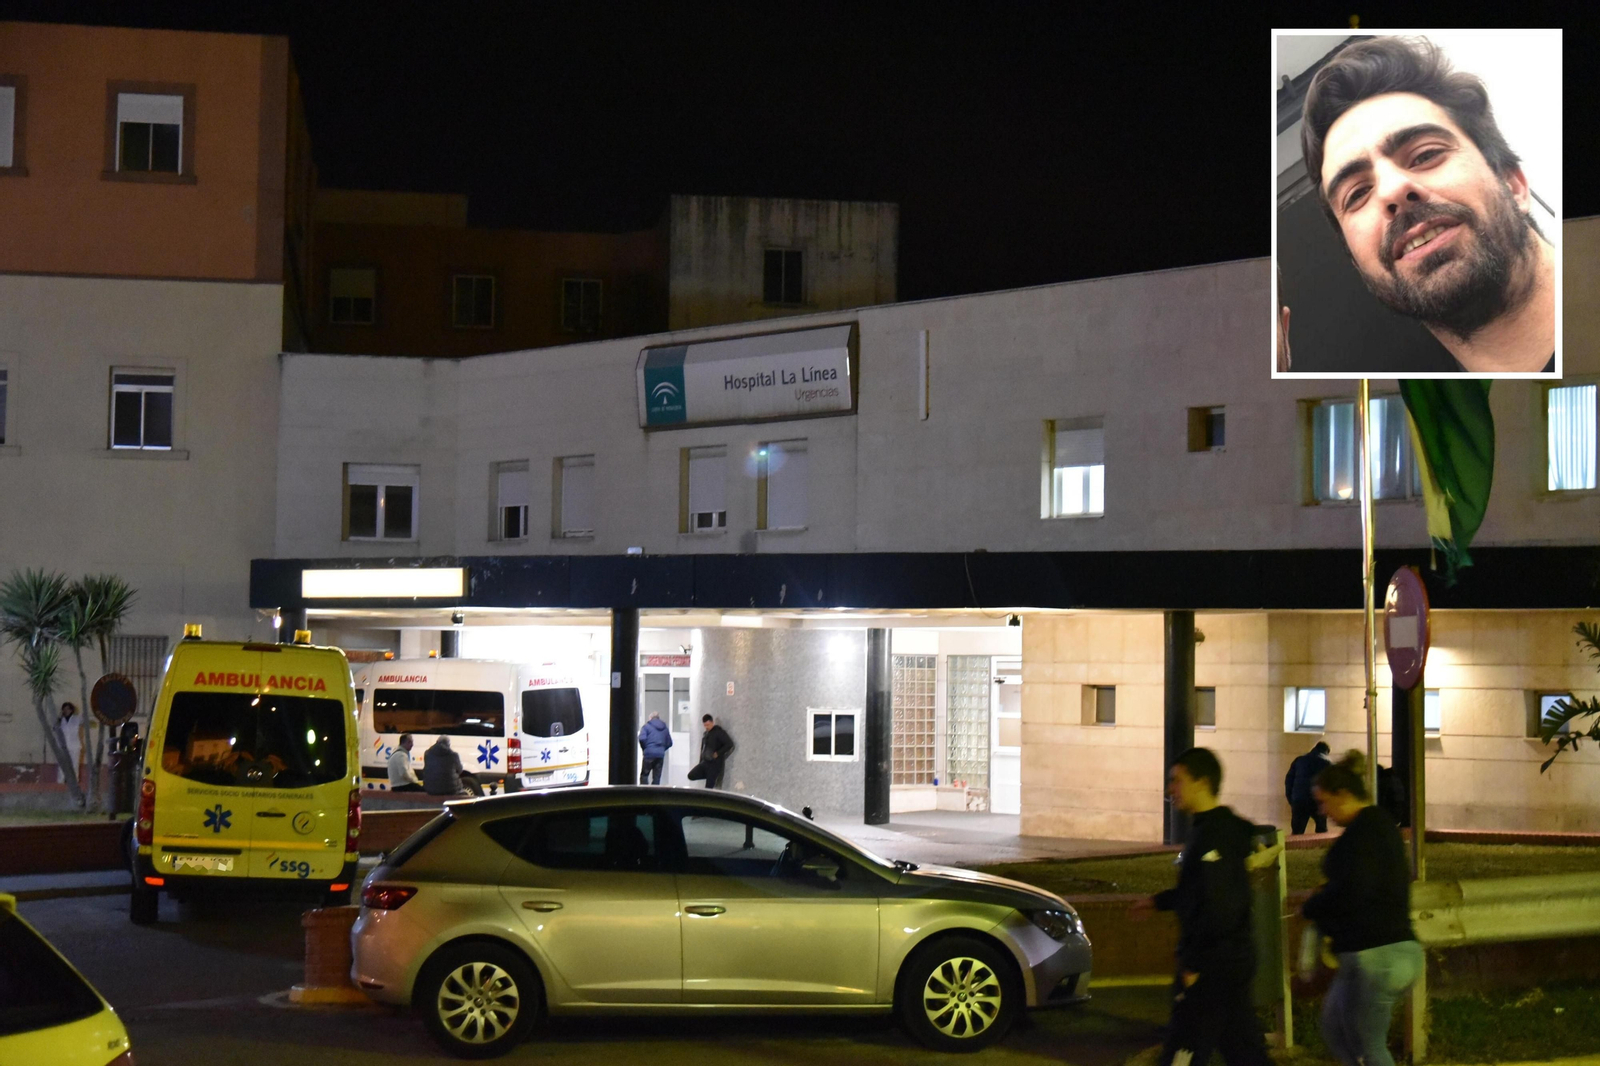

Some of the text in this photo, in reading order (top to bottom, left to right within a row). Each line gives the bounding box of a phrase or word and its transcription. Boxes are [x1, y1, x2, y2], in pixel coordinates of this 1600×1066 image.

[724, 366, 837, 392] Hospital La Línea
[795, 387, 839, 402] Urgencias
[193, 671, 327, 692] AMBULANCIA
[378, 675, 428, 683] AMBULANCIA
[187, 788, 219, 796] SERVICIOS
[241, 791, 276, 799] SANITARIOS
[277, 792, 314, 800] GENERALES
[280, 860, 310, 879] ssg
